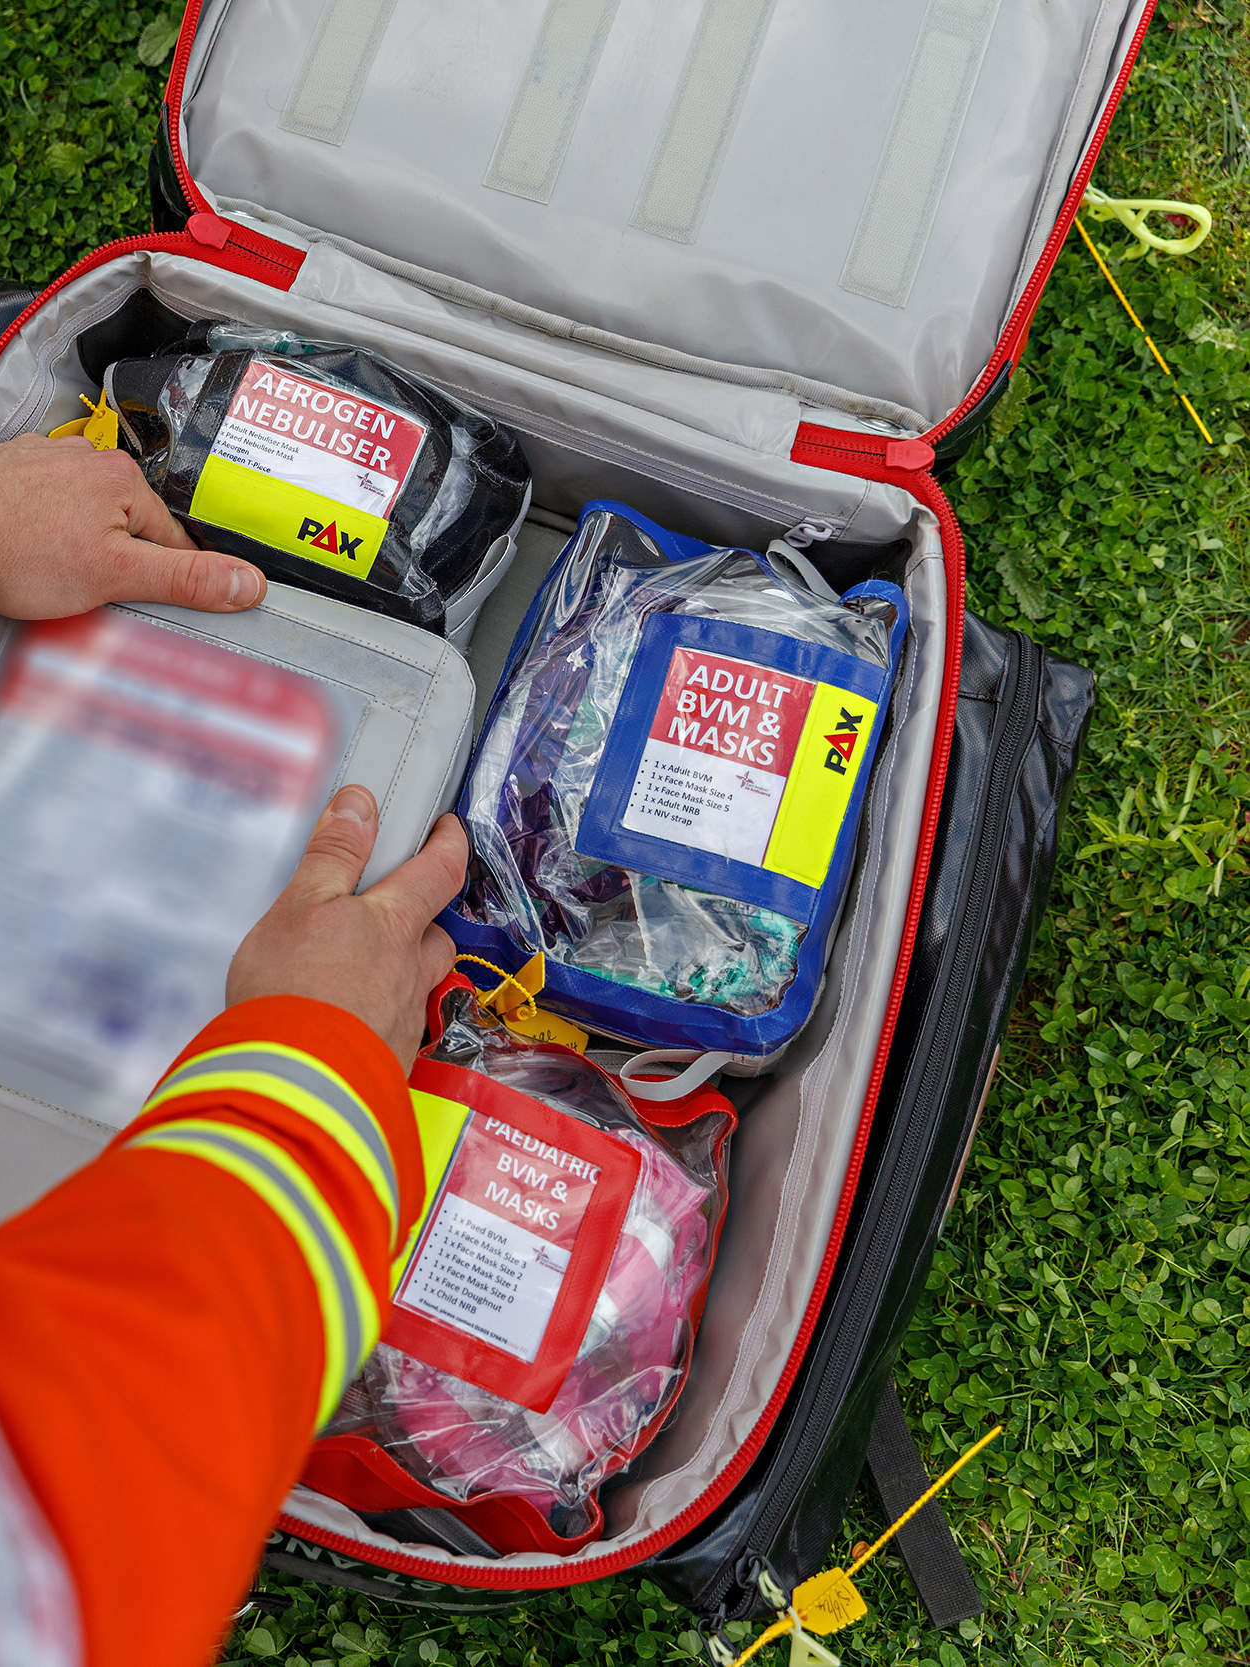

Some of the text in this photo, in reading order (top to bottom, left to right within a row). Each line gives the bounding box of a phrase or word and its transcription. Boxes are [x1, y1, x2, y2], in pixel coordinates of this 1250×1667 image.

[252, 372, 396, 439] AEROGEN
[222, 440, 249, 456] Aeorgen
[225, 432, 242, 442] Paed
[243, 438, 275, 454] Nebuliser
[276, 451, 294, 461] Mask
[230, 423, 247, 433] Adult
[249, 430, 280, 446] Nebuliser
[281, 443, 299, 453] Mask
[233, 395, 391, 471] NEBULISER
[218, 449, 245, 464] Aerogen
[247, 459, 271, 473] T-Piece
[297, 517, 364, 561] PAX
[687, 665, 790, 709] ADULT
[677, 690, 781, 739] BVM &
[667, 716, 776, 766] MASKS
[824, 707, 864, 775] PAX
[664, 776, 683, 786] Face
[685, 781, 708, 794] Mask
[709, 788, 726, 799] Size
[667, 764, 690, 777] Adult
[692, 771, 713, 783] BVM
[654, 809, 670, 819] NIV
[671, 814, 692, 826] strap
[657, 798, 680, 810] Adult
[682, 805, 700, 815] NRB
[661, 787, 680, 798] Face
[682, 792, 704, 805] Mask
[705, 800, 722, 811] Size
[485, 1116, 601, 1185] PAEDIATRIC
[496, 1152, 569, 1203] BVM &
[484, 1181, 560, 1230] MASKS
[461, 1232, 479, 1245] Face
[481, 1241, 502, 1257] Mask
[504, 1252, 519, 1265] Size
[521, 1261, 527, 1269] 3
[466, 1220, 486, 1235] Paed
[487, 1230, 508, 1245] BVM
[438, 1248, 443, 1256] 1
[451, 1254, 470, 1268] Face
[472, 1264, 493, 1280] Mask
[494, 1275, 510, 1288] Size
[512, 1284, 518, 1292] 1
[456, 1243, 475, 1257] Face
[476, 1253, 497, 1268] Mask
[499, 1264, 515, 1276] Size
[516, 1273, 522, 1281] 2
[436, 1290, 458, 1305] Child
[459, 1301, 477, 1314] NRB
[441, 1278, 460, 1292] Face
[461, 1288, 502, 1312] Doughnut
[446, 1266, 465, 1280] Face
[467, 1276, 488, 1292] Mask
[490, 1287, 506, 1300] Size
[508, 1296, 514, 1304] 0
[439, 1309, 455, 1319] please
